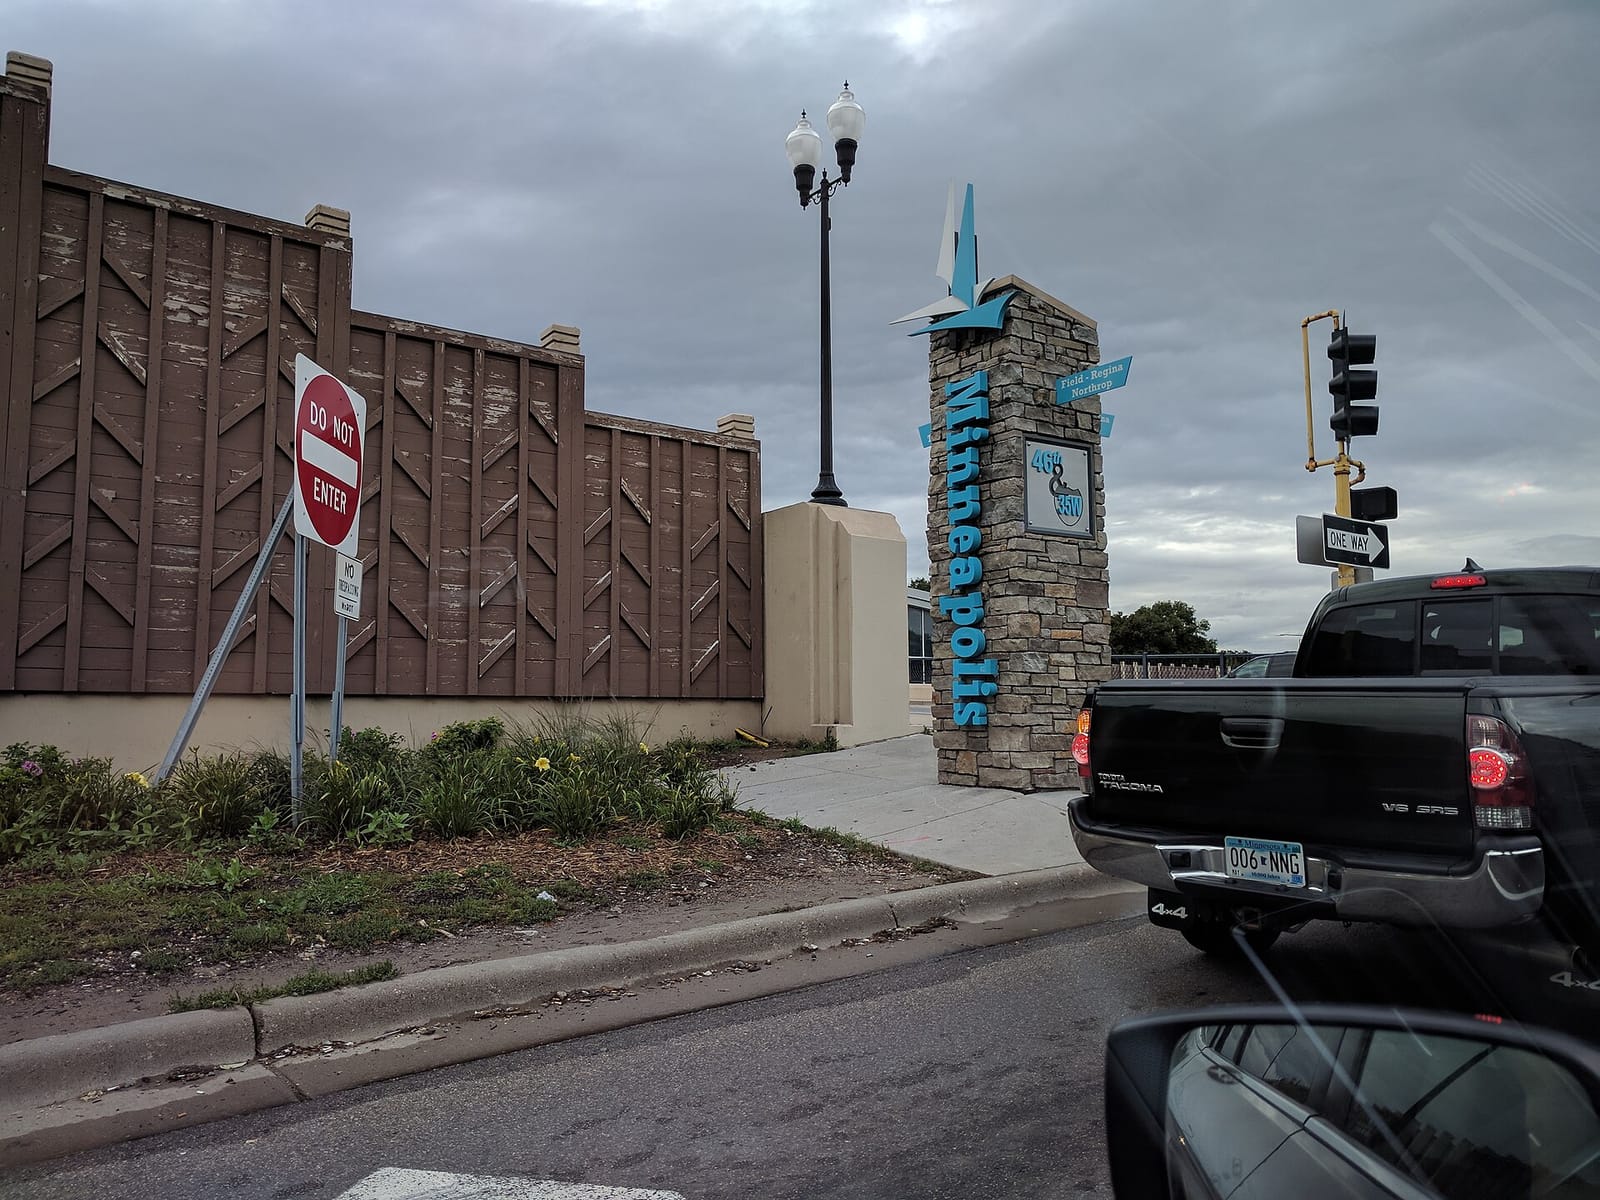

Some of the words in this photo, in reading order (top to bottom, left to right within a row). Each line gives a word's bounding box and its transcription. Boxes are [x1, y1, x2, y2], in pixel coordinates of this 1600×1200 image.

[1061, 374, 1083, 389] Field
[1091, 364, 1123, 380] Regina
[1072, 380, 1113, 397] Northrop
[310, 401, 327, 431] DO
[333, 415, 354, 448] NOT
[314, 477, 347, 515] ENTER
[1057, 494, 1081, 517] 35W
[940, 370, 999, 727] Minneapolis
[1330, 531, 1347, 548] ONE
[1351, 535, 1369, 552] WAY
[344, 562, 355, 579] NO
[1098, 773, 1126, 782] TOYOTA
[1100, 780, 1163, 793] TACOMA
[1230, 847, 1258, 870] 006
[1269, 850, 1300, 875] NNG
[1151, 903, 1188, 919] 4x4
